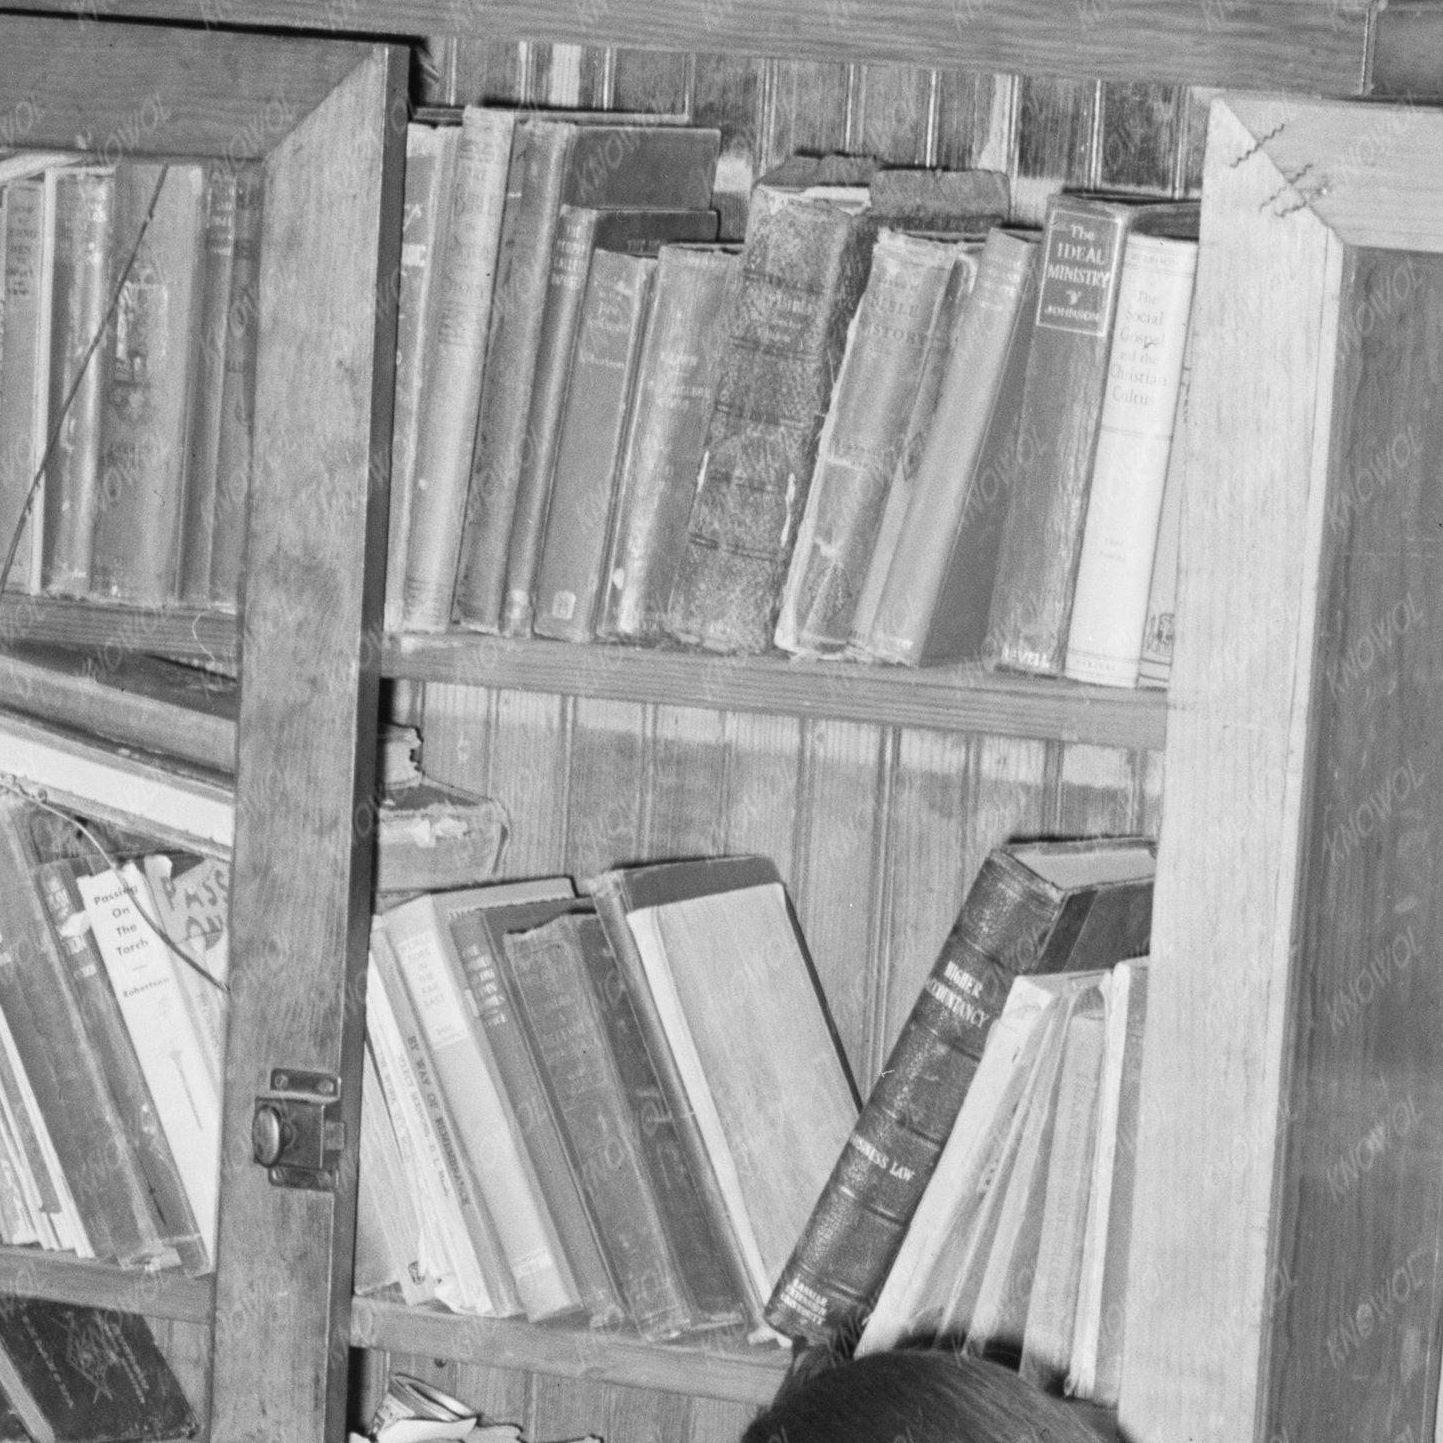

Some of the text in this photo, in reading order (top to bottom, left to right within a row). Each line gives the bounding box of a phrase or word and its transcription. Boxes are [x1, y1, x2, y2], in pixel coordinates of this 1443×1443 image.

[1070, 223, 1095, 242] The
[1056, 242, 1106, 265] IDEAL
[1046, 264, 1112, 290] MINISTRY
[1044, 305, 1100, 323] JOHNSON
[93, 884, 138, 906] Passing
[112, 907, 130, 919] On
[116, 924, 137, 937] The
[117, 937, 149, 956] Torch
[944, 959, 984, 999] HIGHER
[407, 1035, 471, 1206] BY WAY OF REMEMBRANCE
[888, 1159, 915, 1183] LAW
